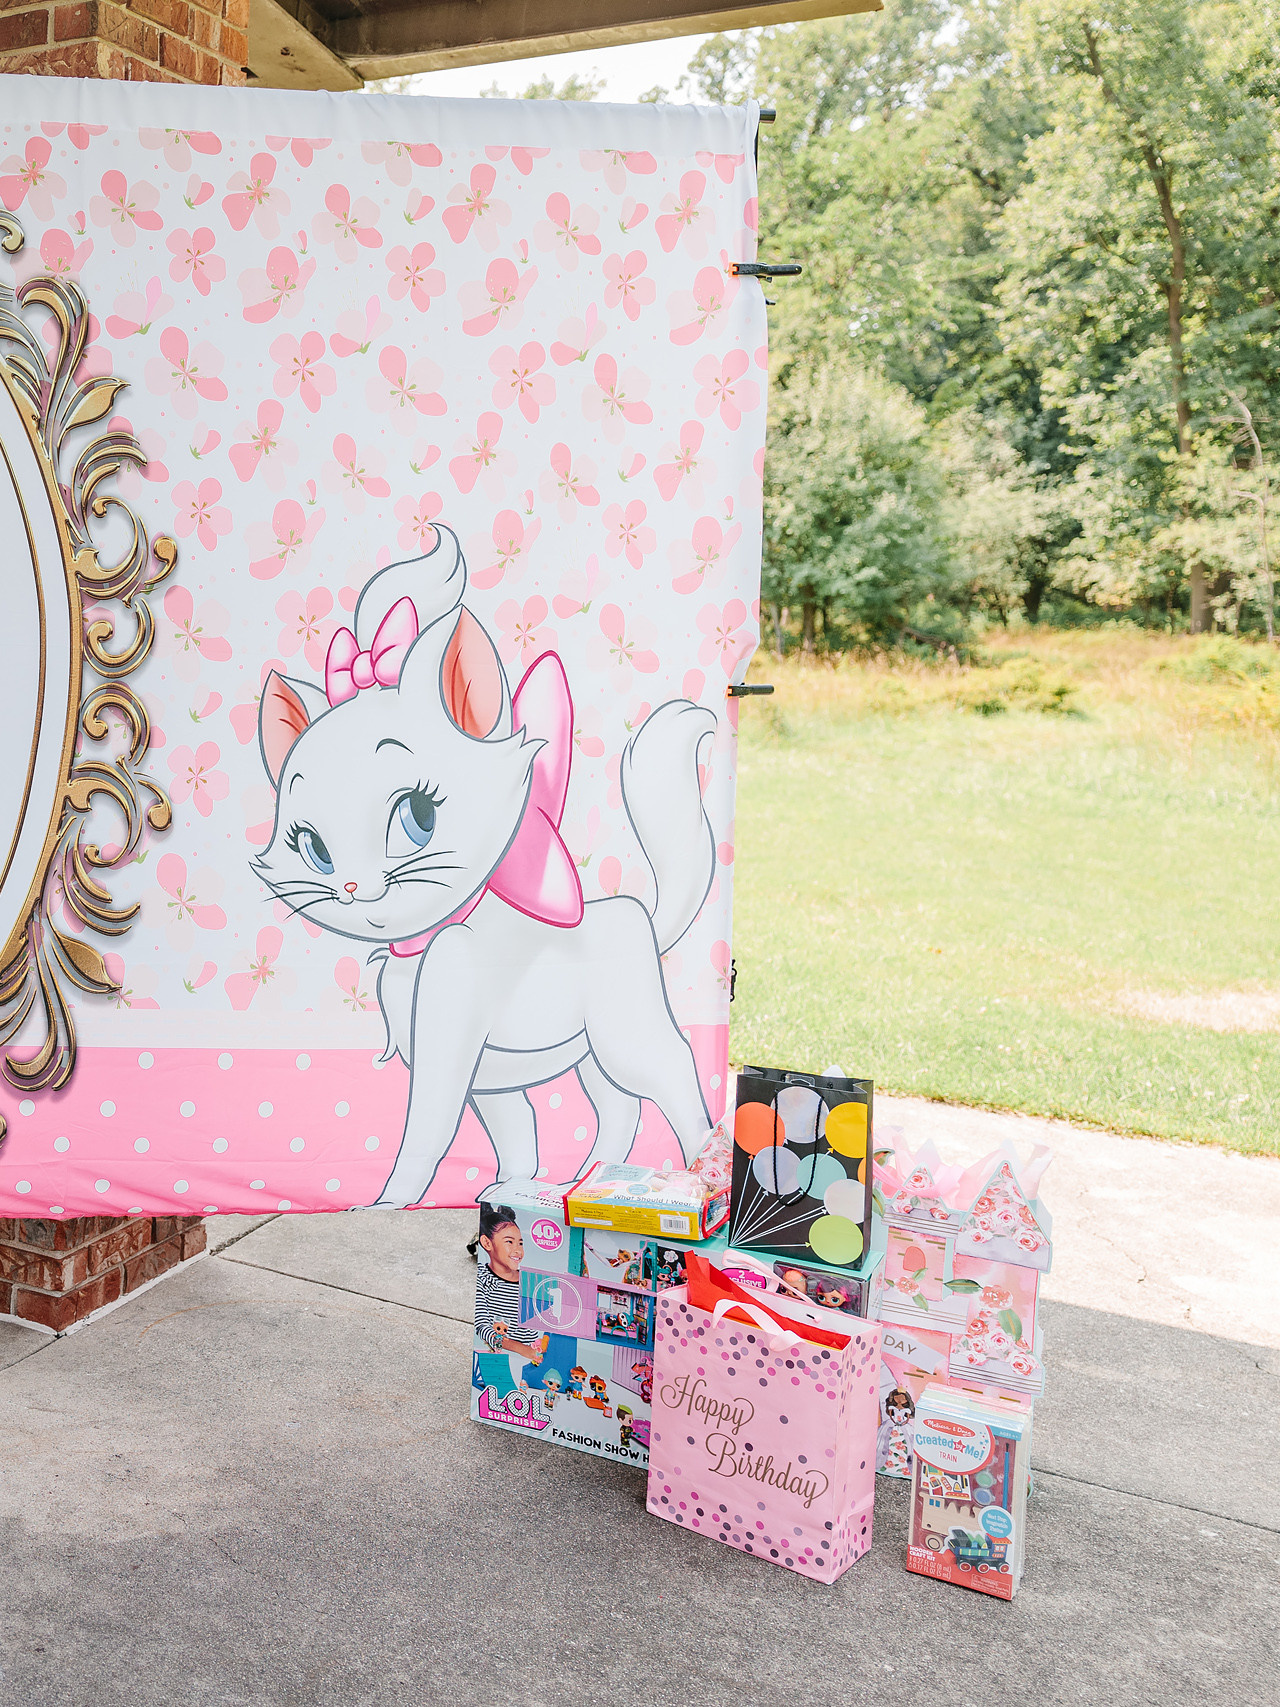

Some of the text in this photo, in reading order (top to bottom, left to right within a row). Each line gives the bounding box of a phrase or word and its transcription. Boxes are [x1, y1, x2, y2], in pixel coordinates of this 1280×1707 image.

[533, 1224, 561, 1240] 40+
[884, 1334, 917, 1355] DAY
[660, 1375, 755, 1436] Happy
[488, 1411, 539, 1429] SURPRISE!
[552, 1428, 601, 1450] FASHION
[604, 1443, 640, 1460] SHOW
[915, 1433, 984, 1461] Created by Me!
[939, 1451, 958, 1463] TRAIN
[705, 1432, 829, 1509] Birthday
[909, 1546, 933, 1555] WOODEN
